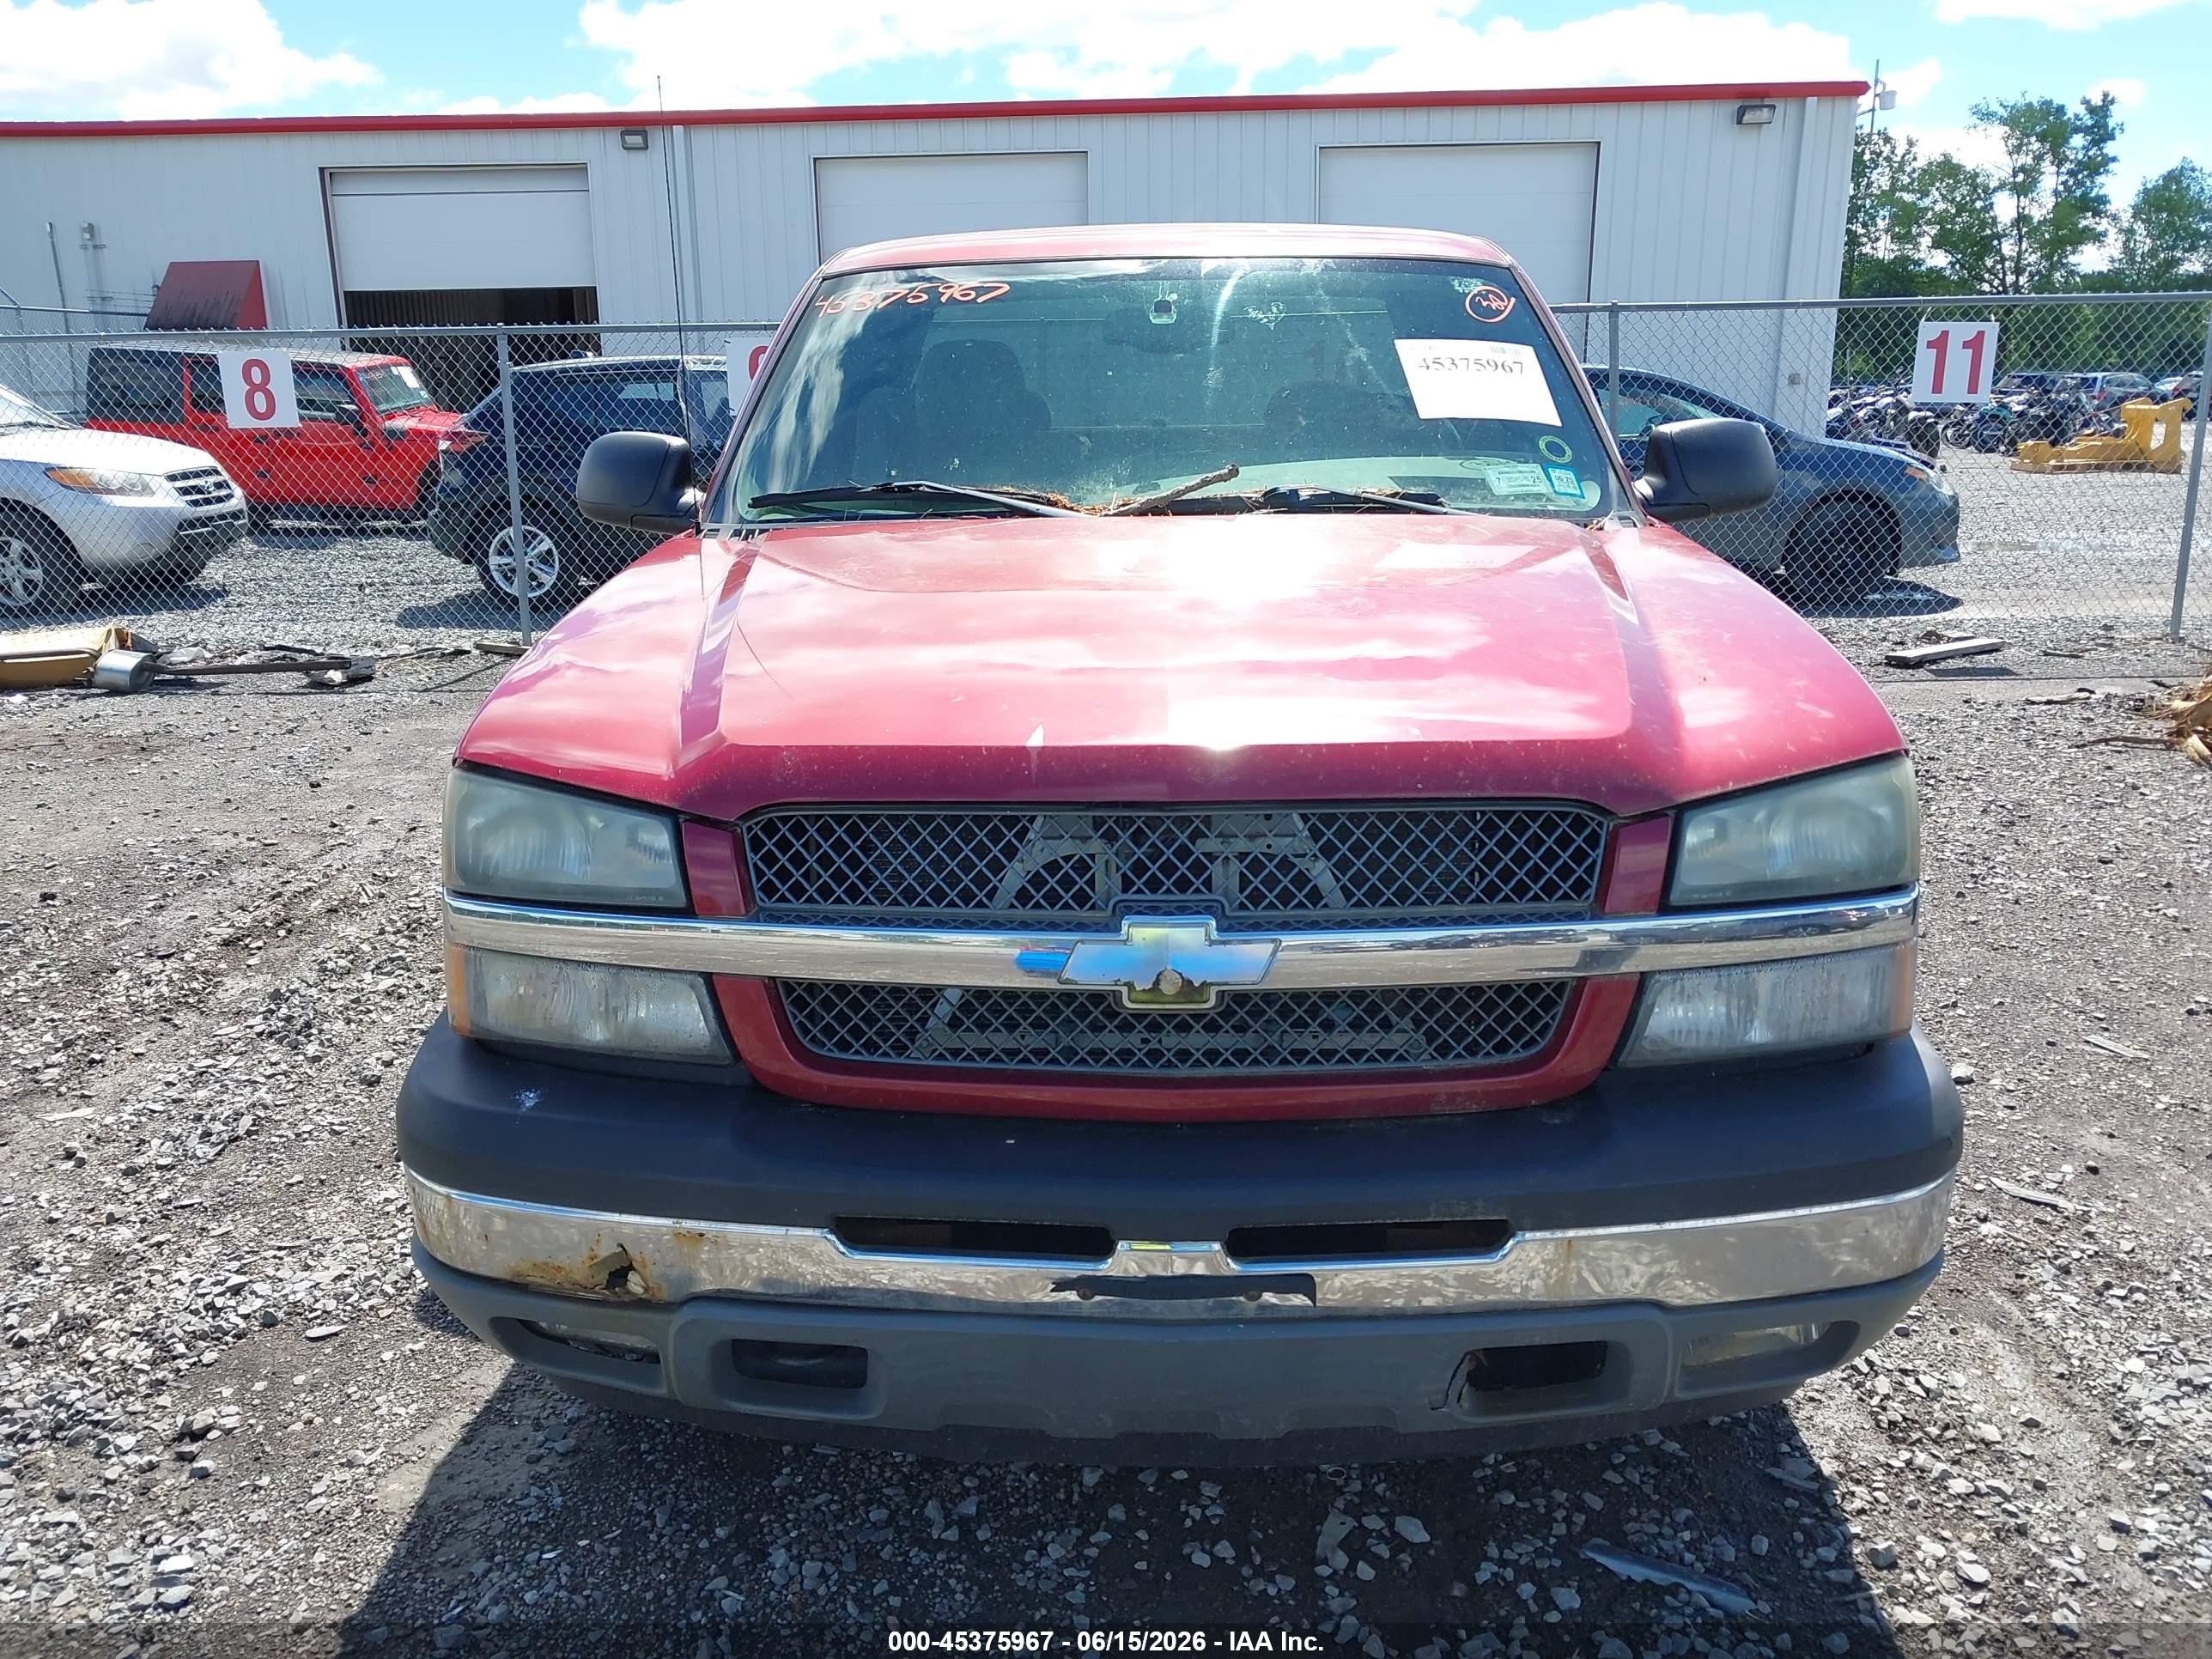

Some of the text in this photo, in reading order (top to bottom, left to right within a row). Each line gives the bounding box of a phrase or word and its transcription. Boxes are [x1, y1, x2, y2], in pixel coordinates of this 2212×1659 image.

[815, 283, 1011, 318] 45375967
[1418, 356, 1523, 375] 45375967
[1925, 330, 1985, 395] 11
[241, 358, 276, 421] 8
